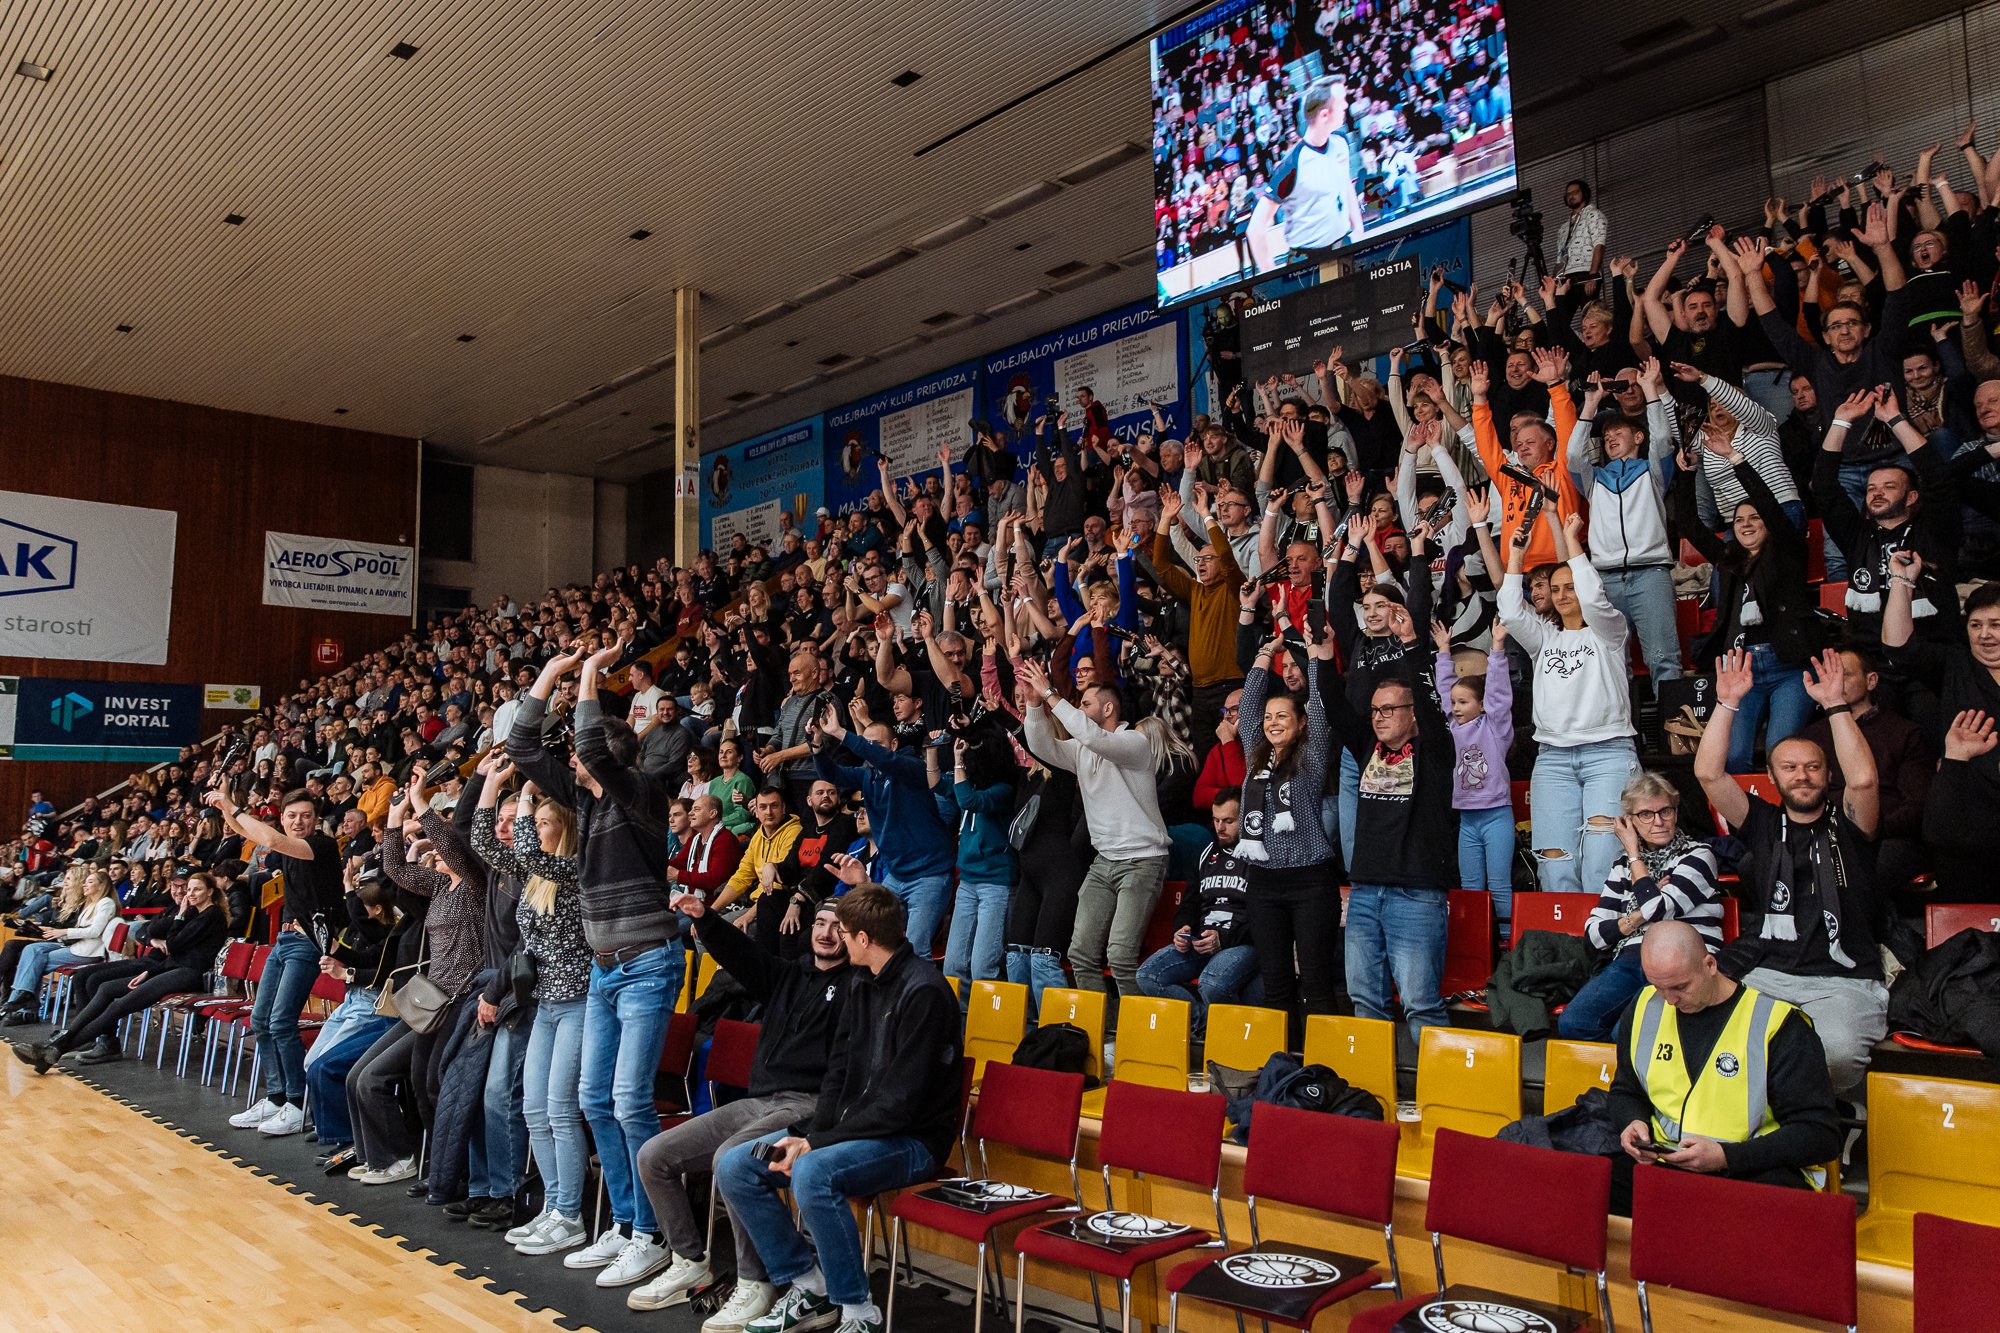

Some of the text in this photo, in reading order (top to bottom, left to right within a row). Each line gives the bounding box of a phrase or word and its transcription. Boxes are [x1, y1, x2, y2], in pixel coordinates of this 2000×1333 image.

[1370, 260, 1412, 280] HOSTIA
[1245, 300, 1281, 318] DOMÁCI
[1381, 304, 1405, 315] TRESTY
[1351, 317, 1370, 327] FAULY
[1313, 326, 1339, 337] PERIÓDA
[988, 335, 1065, 375] VOLEJBALOVÝ
[1068, 327, 1098, 348] KLUB
[1102, 310, 1161, 337] PRIEVID
[1253, 342, 1273, 351] TRESTY
[1284, 336, 1301, 345] FAULY
[829, 373, 967, 428] VOLEJBALOVÝ KLUB PRIEVIDZA
[677, 479, 682, 495] A
[687, 479, 695, 495] A
[0, 543, 57, 581] K
[303, 582, 335, 593] LIETADIEL
[337, 585, 368, 595] DYNAMIC
[375, 589, 408, 599] ADVANTIC
[4, 614, 93, 637] starostí
[104, 696, 171, 711] INVEST
[1696, 691, 1703, 702] 5
[1693, 706, 1707, 717] VIP
[104, 714, 170, 728] PORTAL
[802, 846, 821, 857] HUO
[274, 882, 280, 895] 1
[1553, 904, 1562, 921] 5
[992, 994, 1001, 1011] 10
[1149, 1013, 1157, 1030] 8
[1243, 1023, 1251, 1040] 7
[1465, 1048, 1475, 1069] 5
[1655, 1042, 1674, 1062] 23
[1599, 1063, 1611, 1084] 4
[1942, 1103, 1955, 1129] 2
